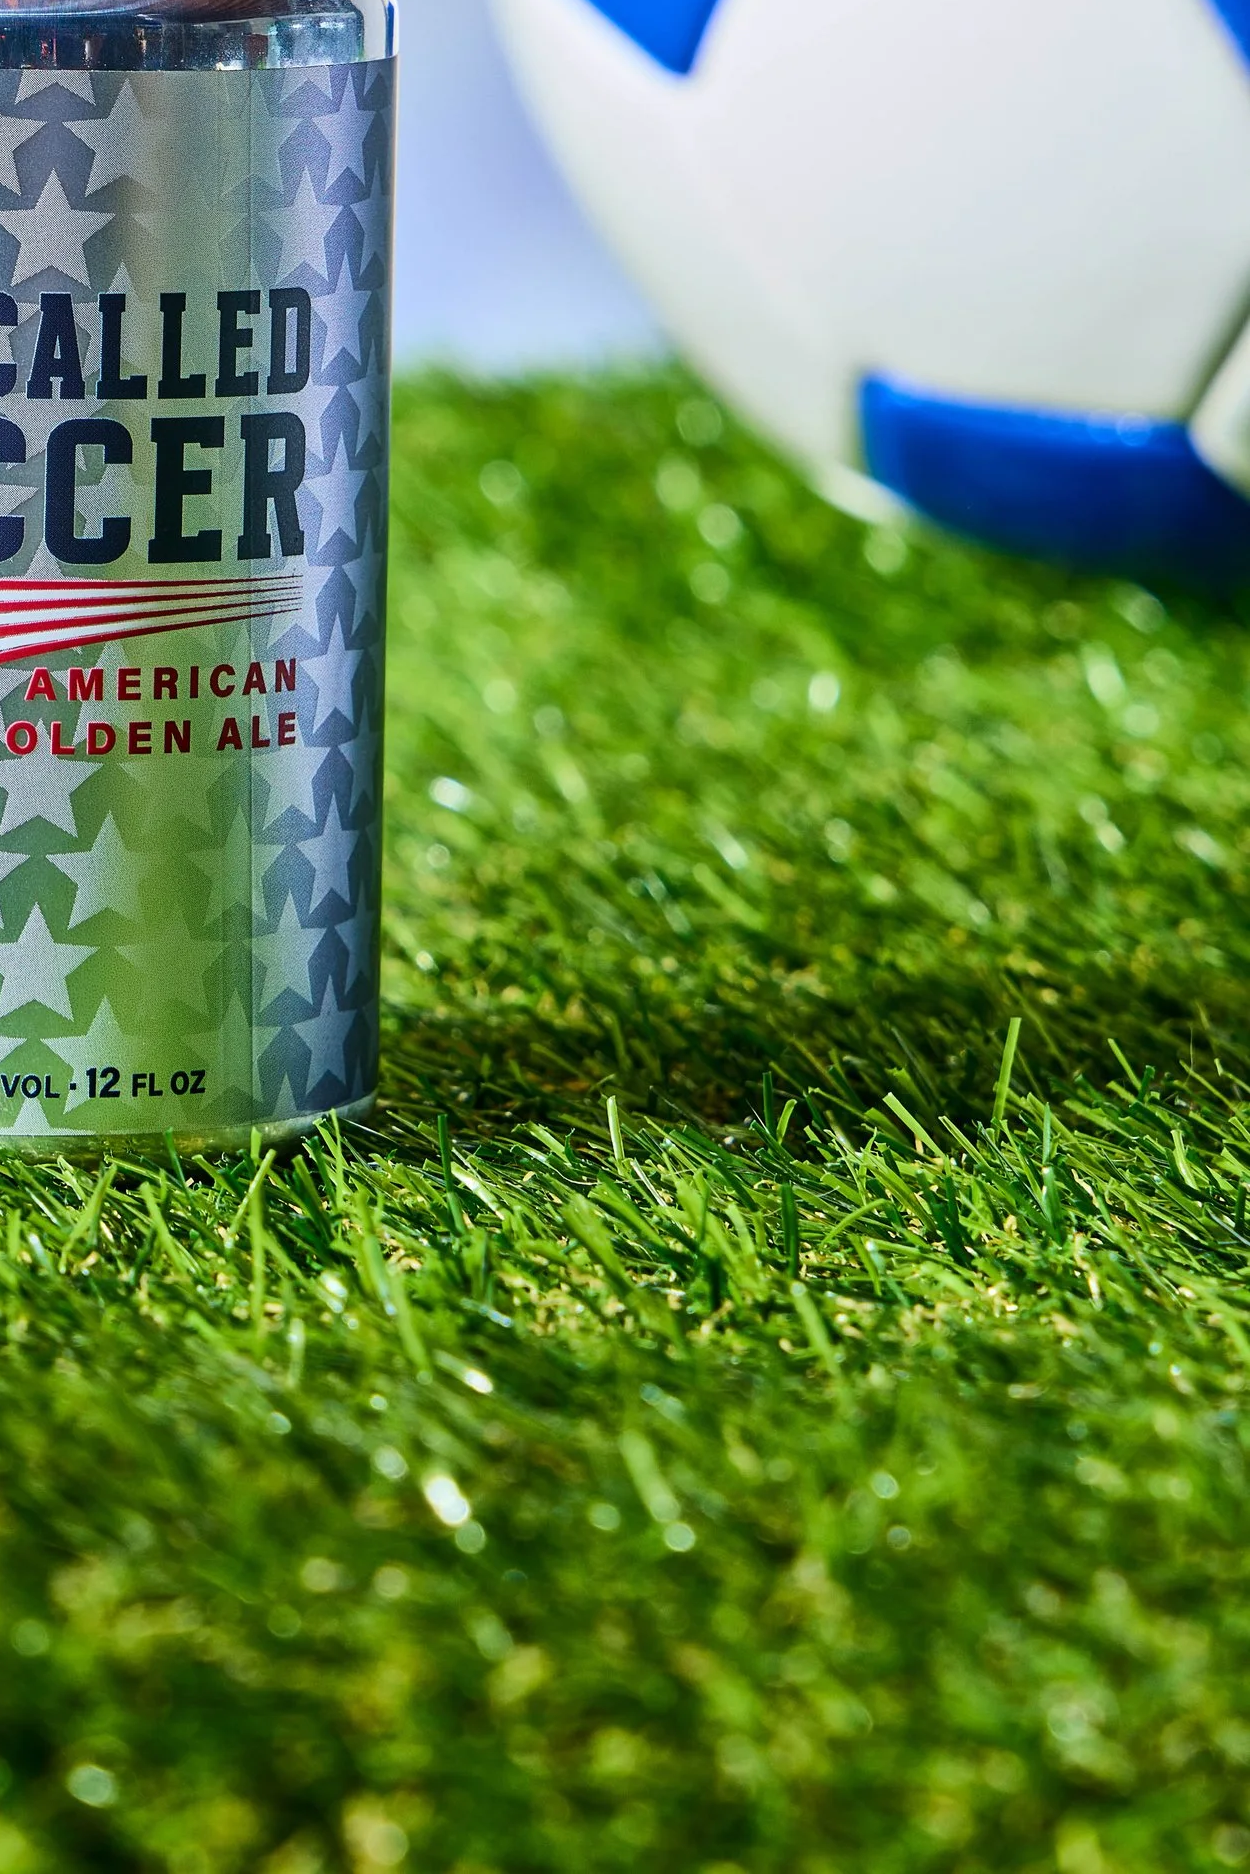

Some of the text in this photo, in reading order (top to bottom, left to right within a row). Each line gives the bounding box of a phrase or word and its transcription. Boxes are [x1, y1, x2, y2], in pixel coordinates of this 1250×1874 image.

[25, 657, 297, 701] AMERICAN
[217, 711, 296, 751] ALE
[86, 1067, 120, 1098] 12
[132, 1072, 163, 1097] FL
[171, 1070, 206, 1094] OZ
